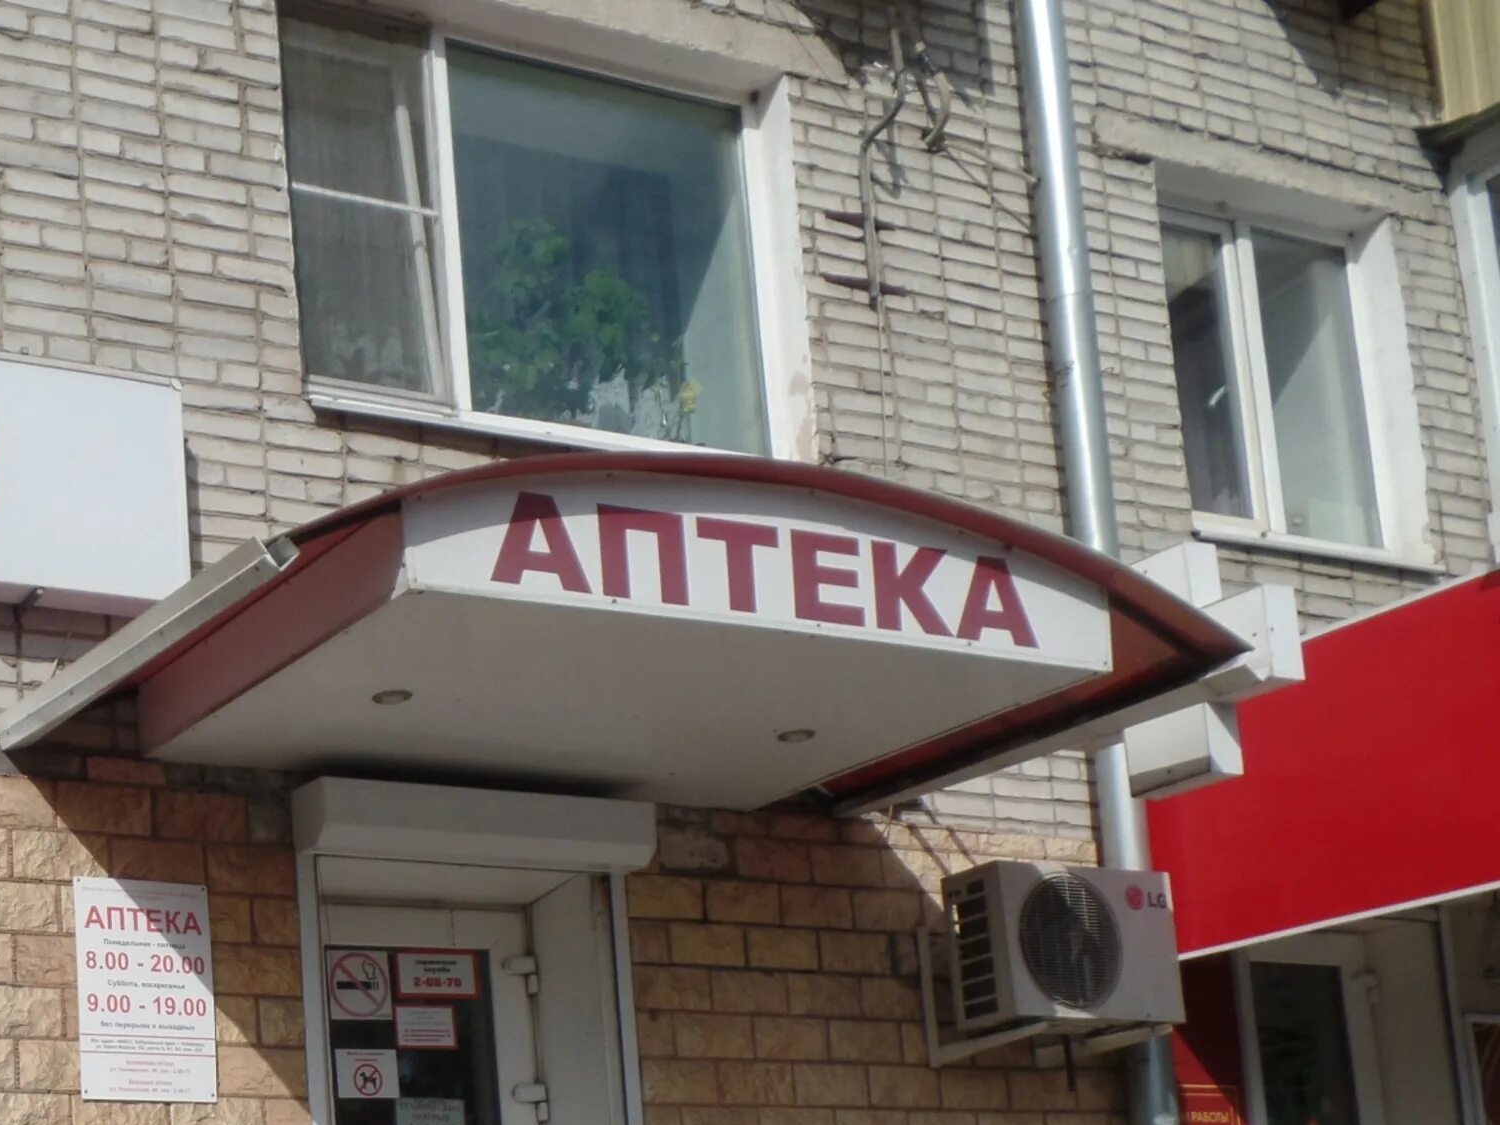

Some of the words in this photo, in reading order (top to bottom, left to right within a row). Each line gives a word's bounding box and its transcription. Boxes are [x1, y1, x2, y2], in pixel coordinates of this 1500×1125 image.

[490, 491, 1040, 649] АПТЕКА
[1147, 892, 1167, 908] LG
[84, 905, 202, 935] АПТЕКА
[86, 951, 129, 971] 8.00
[150, 954, 205, 975] 20.00
[87, 993, 131, 1013] 9.00
[153, 996, 207, 1017] 19.00
